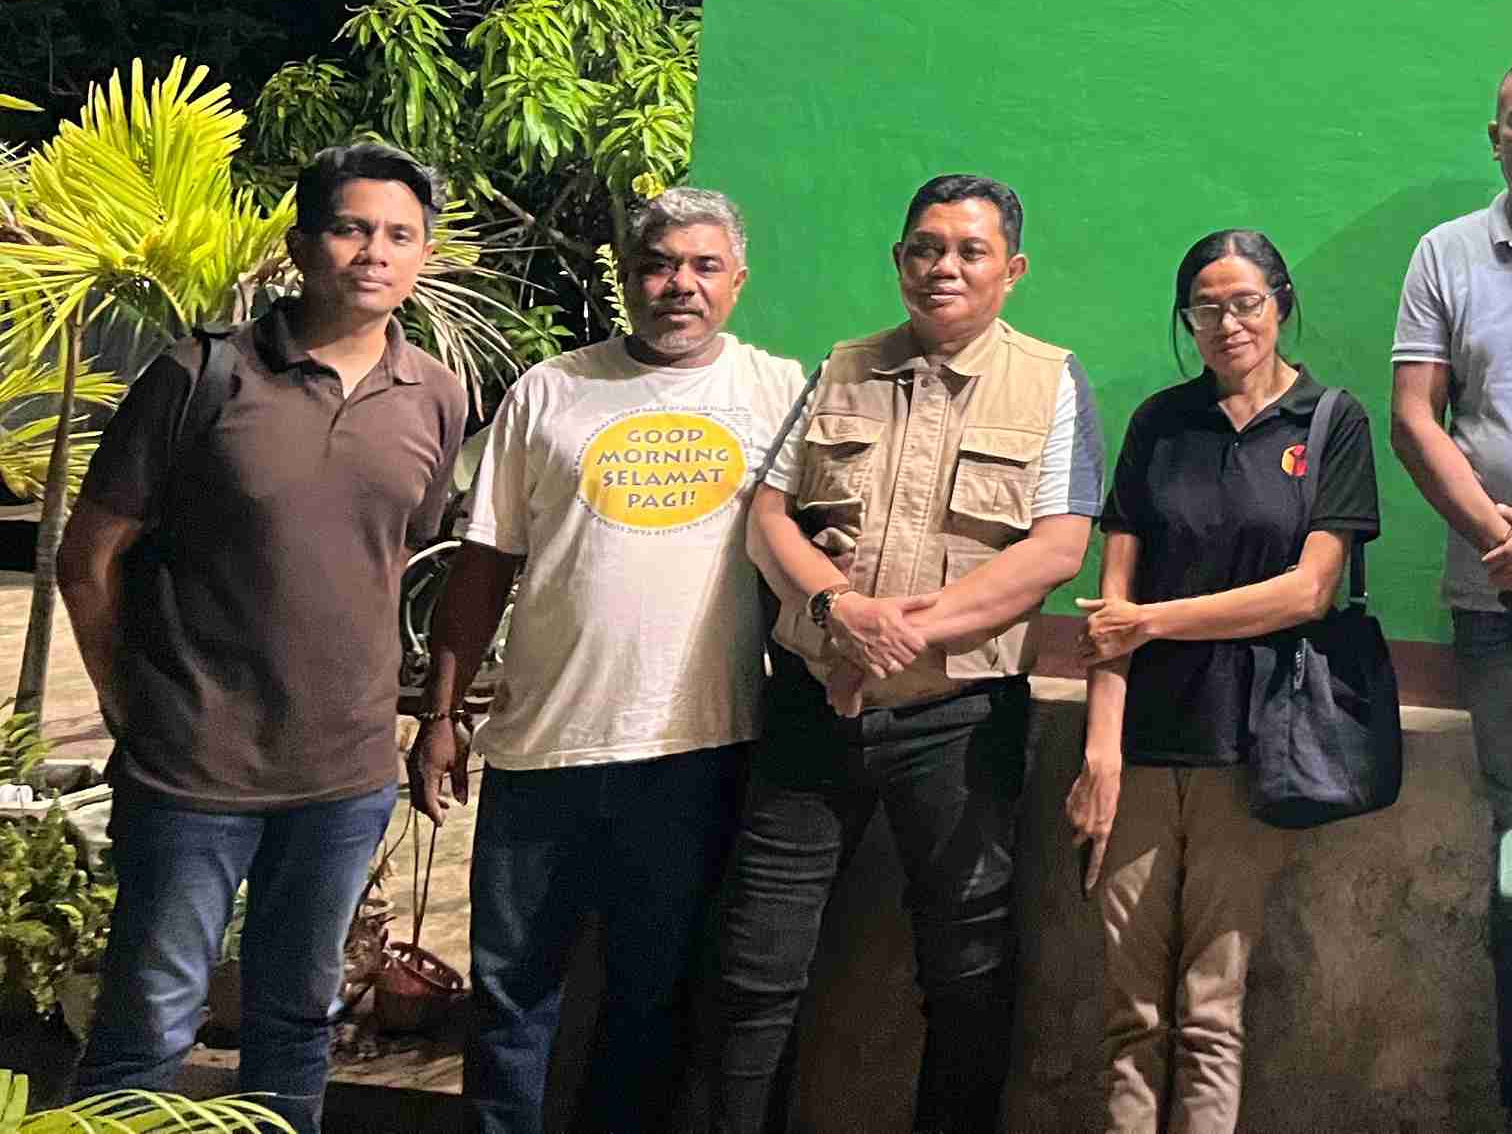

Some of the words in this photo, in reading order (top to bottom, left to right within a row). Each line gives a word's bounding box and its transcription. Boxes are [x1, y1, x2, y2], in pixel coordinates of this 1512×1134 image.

[626, 428, 704, 444] GOOD
[597, 448, 729, 465] MORNING
[602, 468, 725, 487] SELAMAT
[627, 491, 697, 508] PAGI!
